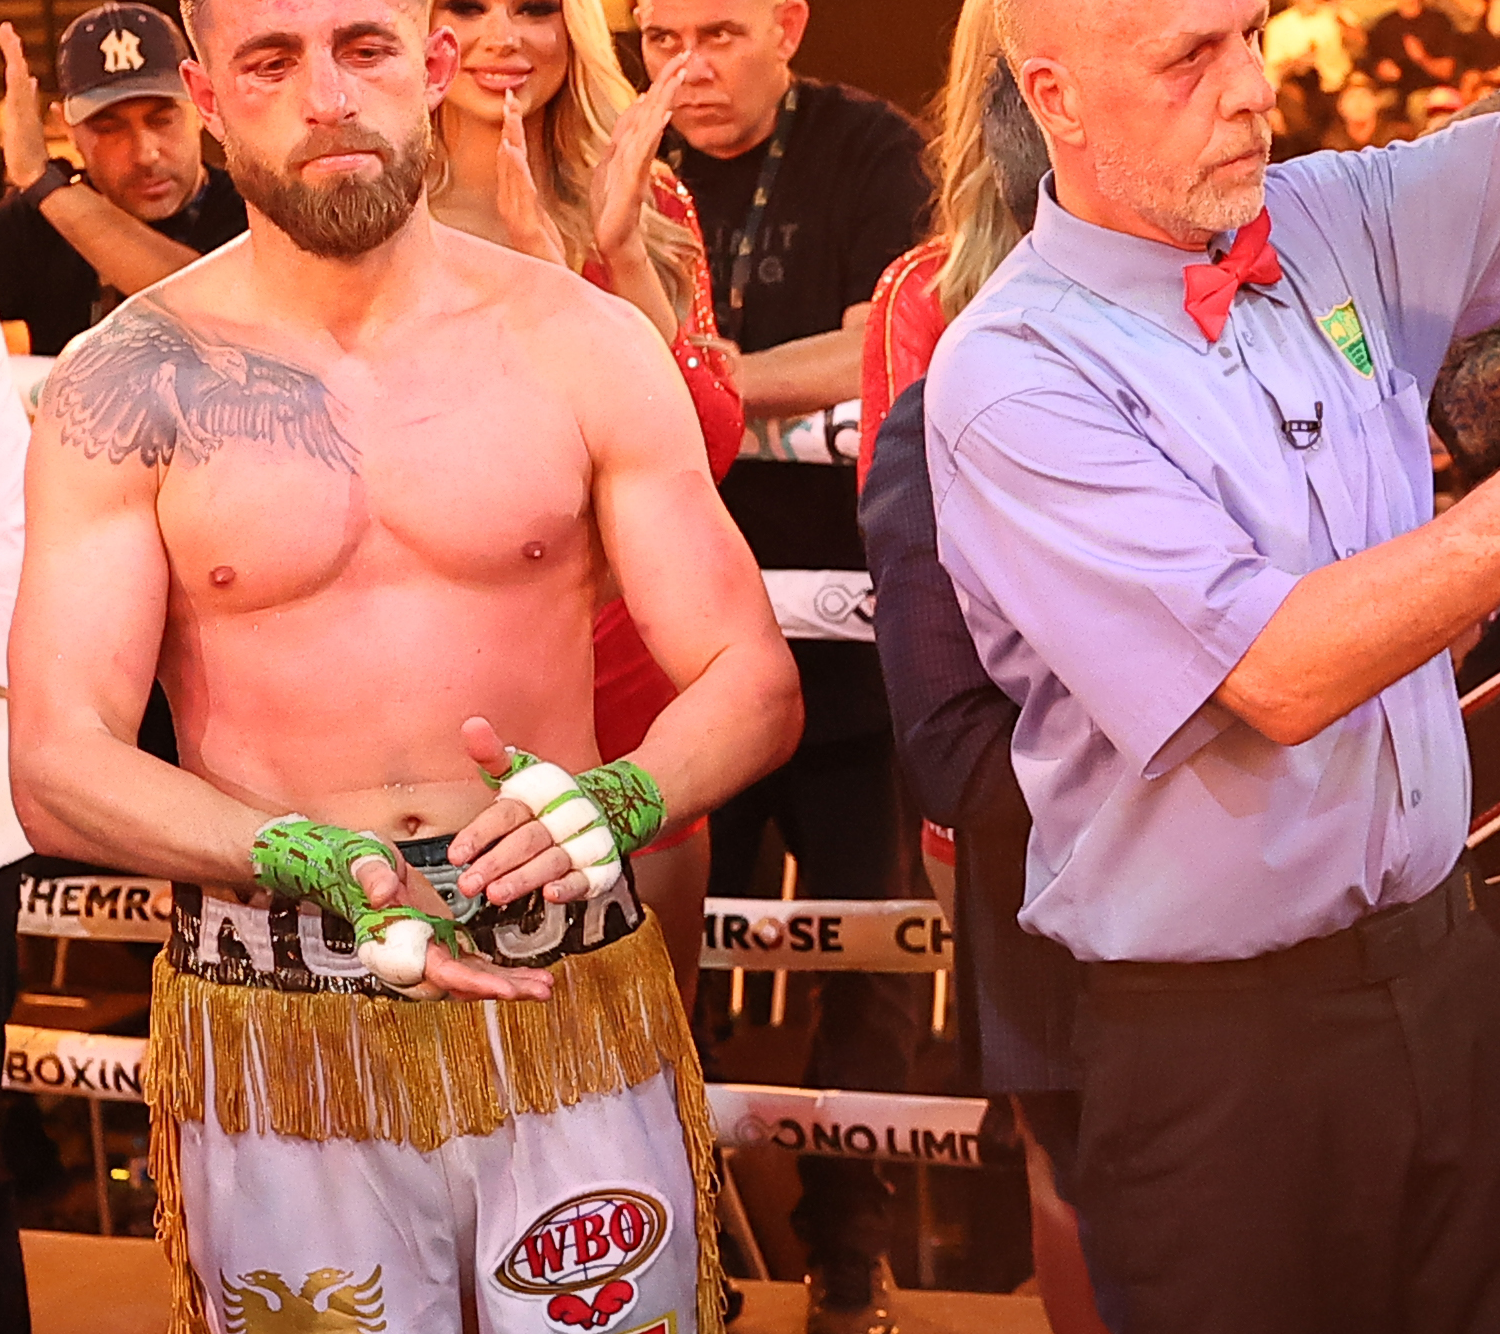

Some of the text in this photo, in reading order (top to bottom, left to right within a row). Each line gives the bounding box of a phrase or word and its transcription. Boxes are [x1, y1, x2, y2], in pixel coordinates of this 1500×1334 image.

[21, 873, 173, 921] HEMRO
[200, 872, 641, 978] NUJA
[7, 1051, 143, 1094] BOXIN
[524, 1203, 645, 1279] WBO
